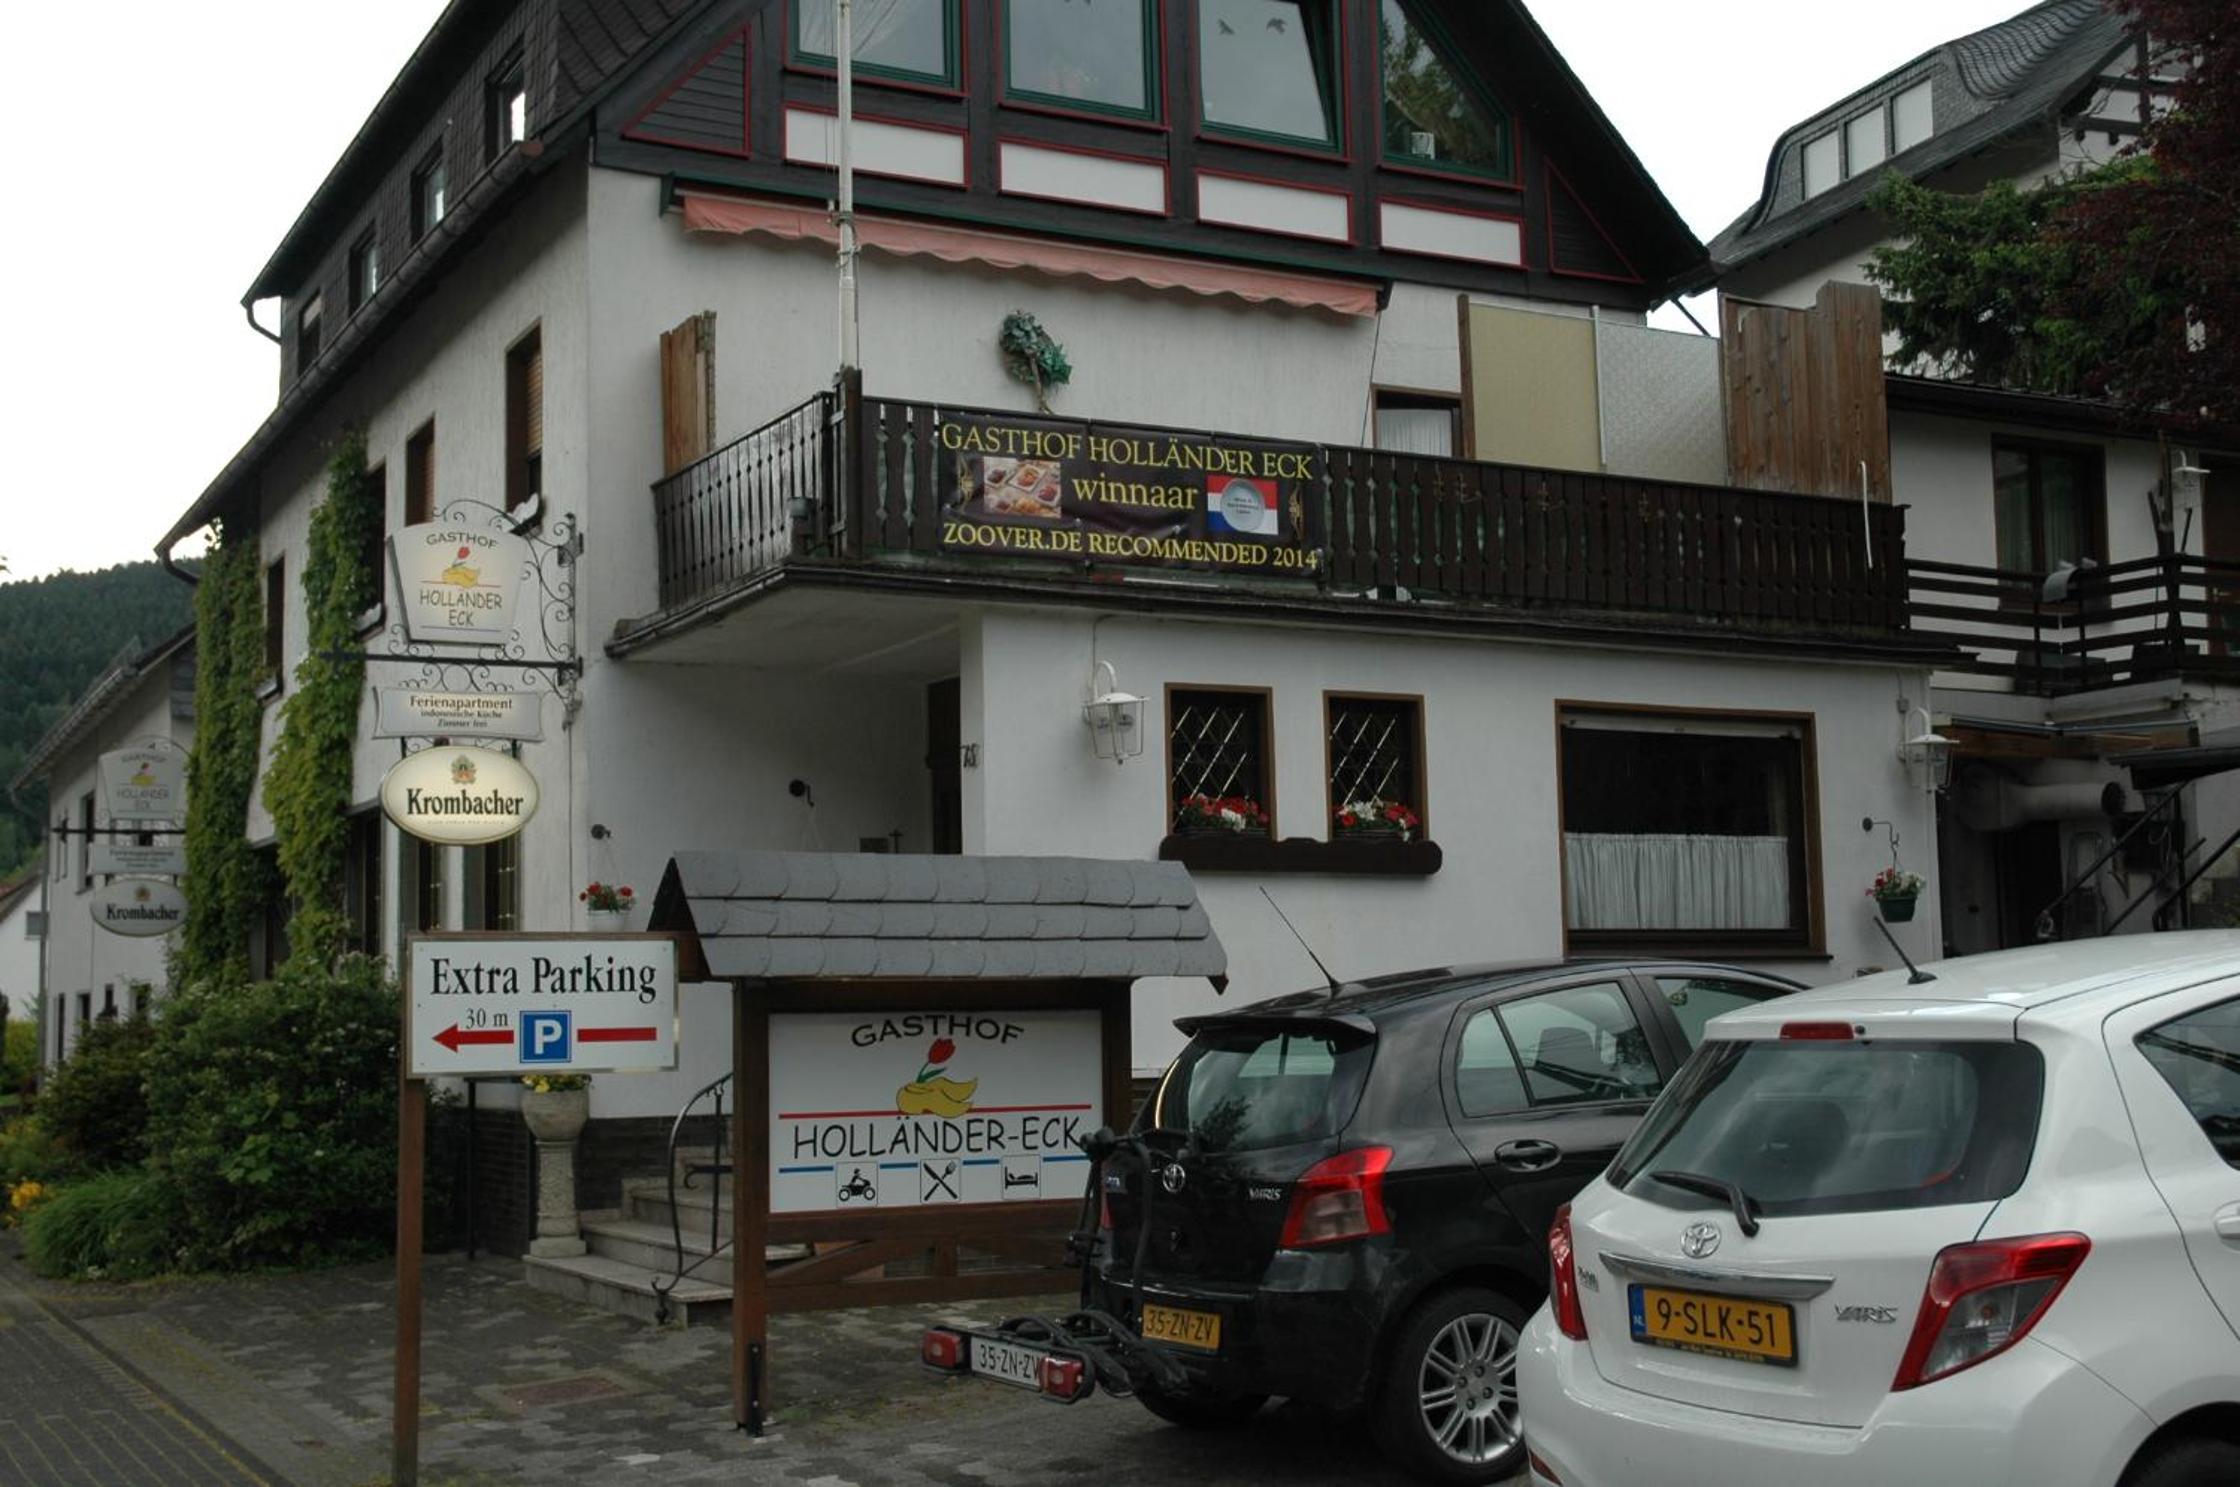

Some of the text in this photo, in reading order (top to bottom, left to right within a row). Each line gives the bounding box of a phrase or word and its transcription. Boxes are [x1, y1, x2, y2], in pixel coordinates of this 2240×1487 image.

[942, 423, 1313, 480] GASTHOF HOLLÄNDER ECK
[1072, 472, 1198, 510] winnaar
[426, 531, 499, 549] GASTHOF
[943, 522, 1319, 570] ZOOVER.DE RECOMMENDED 2014
[448, 609, 474, 627] ECK
[410, 695, 513, 711] Ferienapartment
[406, 788, 524, 815] Krombacher
[106, 903, 180, 921] Krombacher
[430, 953, 657, 1004] Extra Parking
[465, 1008, 509, 1029] 30 m
[851, 1014, 1025, 1047] GASTHOF
[534, 1019, 563, 1055] P
[793, 1115, 1081, 1159] HOLLÄNDER-ECK
[1145, 1308, 1215, 1341] 35-ZN-ZV
[1657, 1298, 1776, 1347] 9-SLK-51
